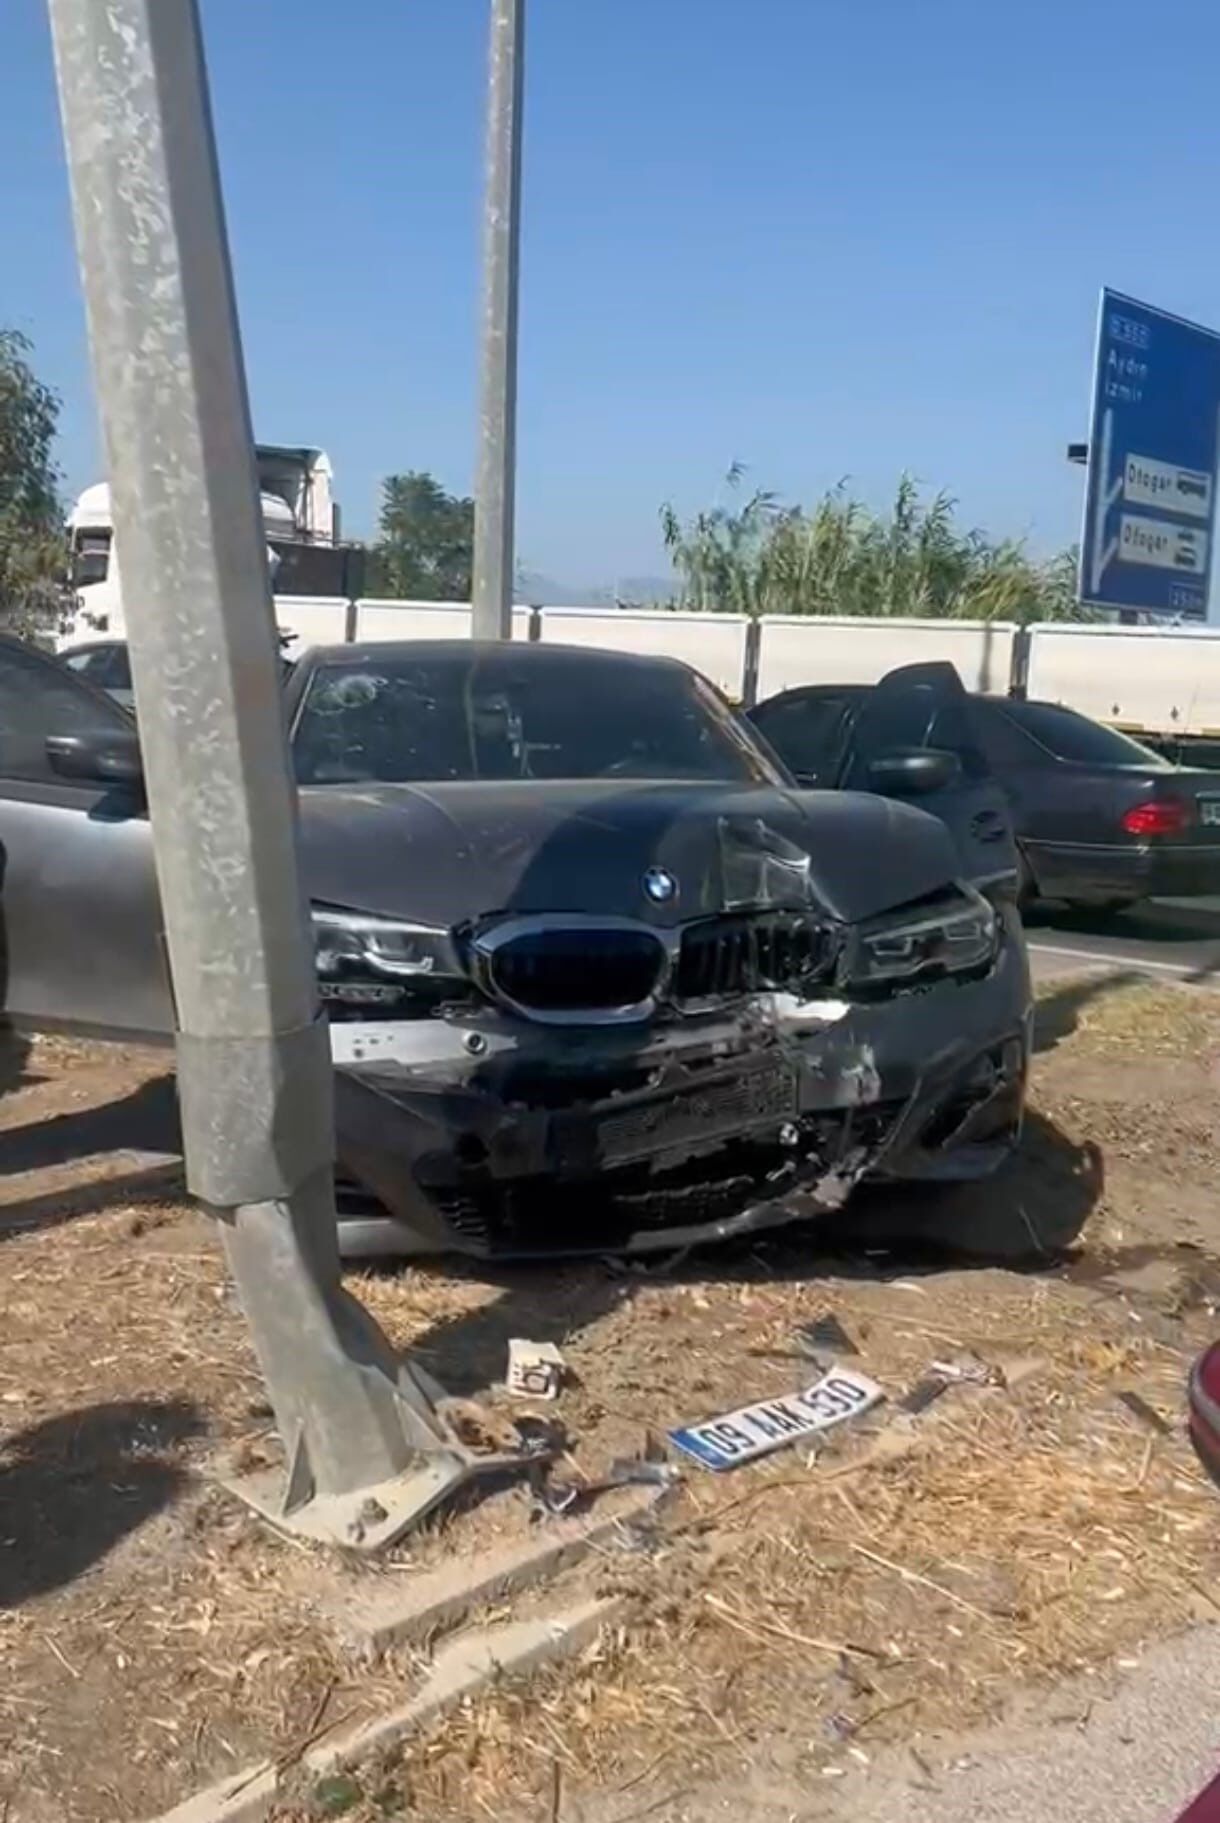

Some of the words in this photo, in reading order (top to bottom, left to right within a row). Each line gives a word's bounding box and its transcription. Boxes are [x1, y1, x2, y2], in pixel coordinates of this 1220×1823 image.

[1128, 462, 1172, 493] Otogar
[1123, 523, 1168, 554] Otogar
[699, 1422, 756, 1455] 09
[799, 1377, 867, 1418] 530
